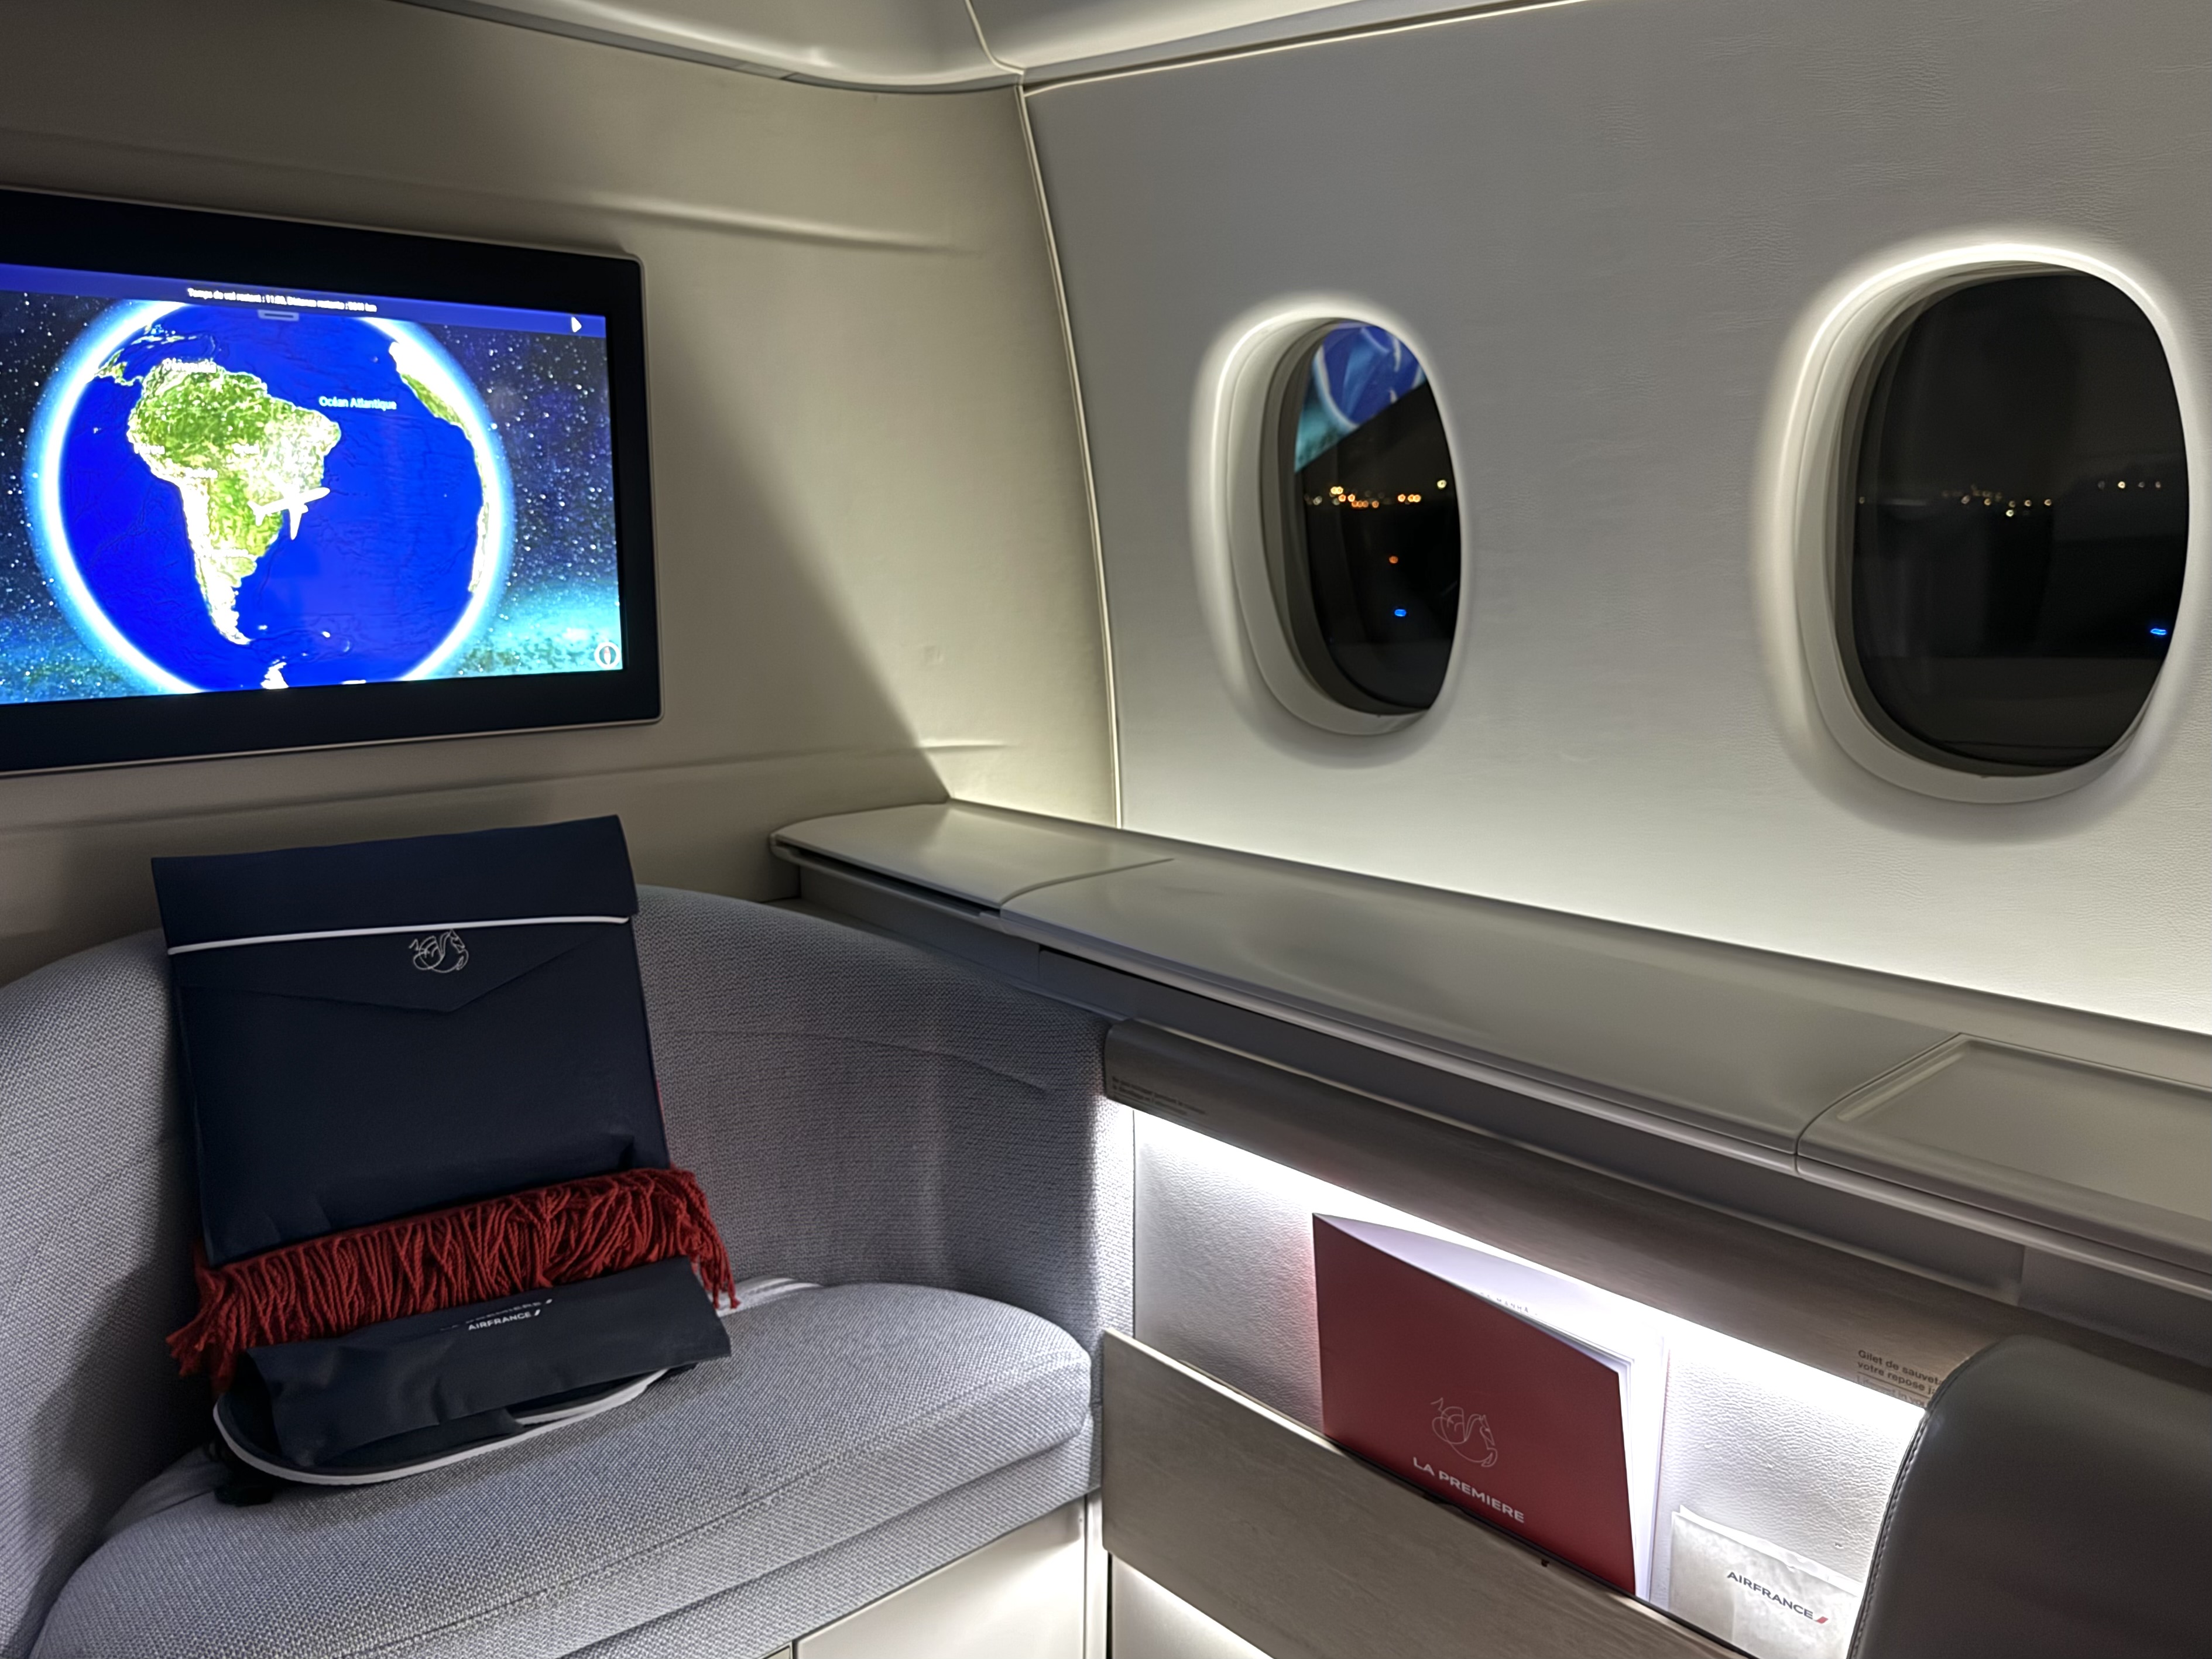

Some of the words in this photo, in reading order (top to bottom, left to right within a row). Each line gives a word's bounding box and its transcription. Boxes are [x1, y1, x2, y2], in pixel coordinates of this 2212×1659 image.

[213, 290, 224, 299] de
[318, 396, 349, 407] Océan
[349, 397, 397, 411] Atlantique
[468, 1311, 531, 1331] AIRFRANCE
[1858, 1349, 1882, 1365] Gilet
[1885, 1361, 1899, 1370] de
[1857, 1362, 1884, 1376] votre
[1888, 1372, 1925, 1391] repose
[1413, 1456, 1435, 1476] LA
[1439, 1471, 1524, 1523] PREMIERE
[1727, 1572, 1813, 1619] AIRFRANCE
